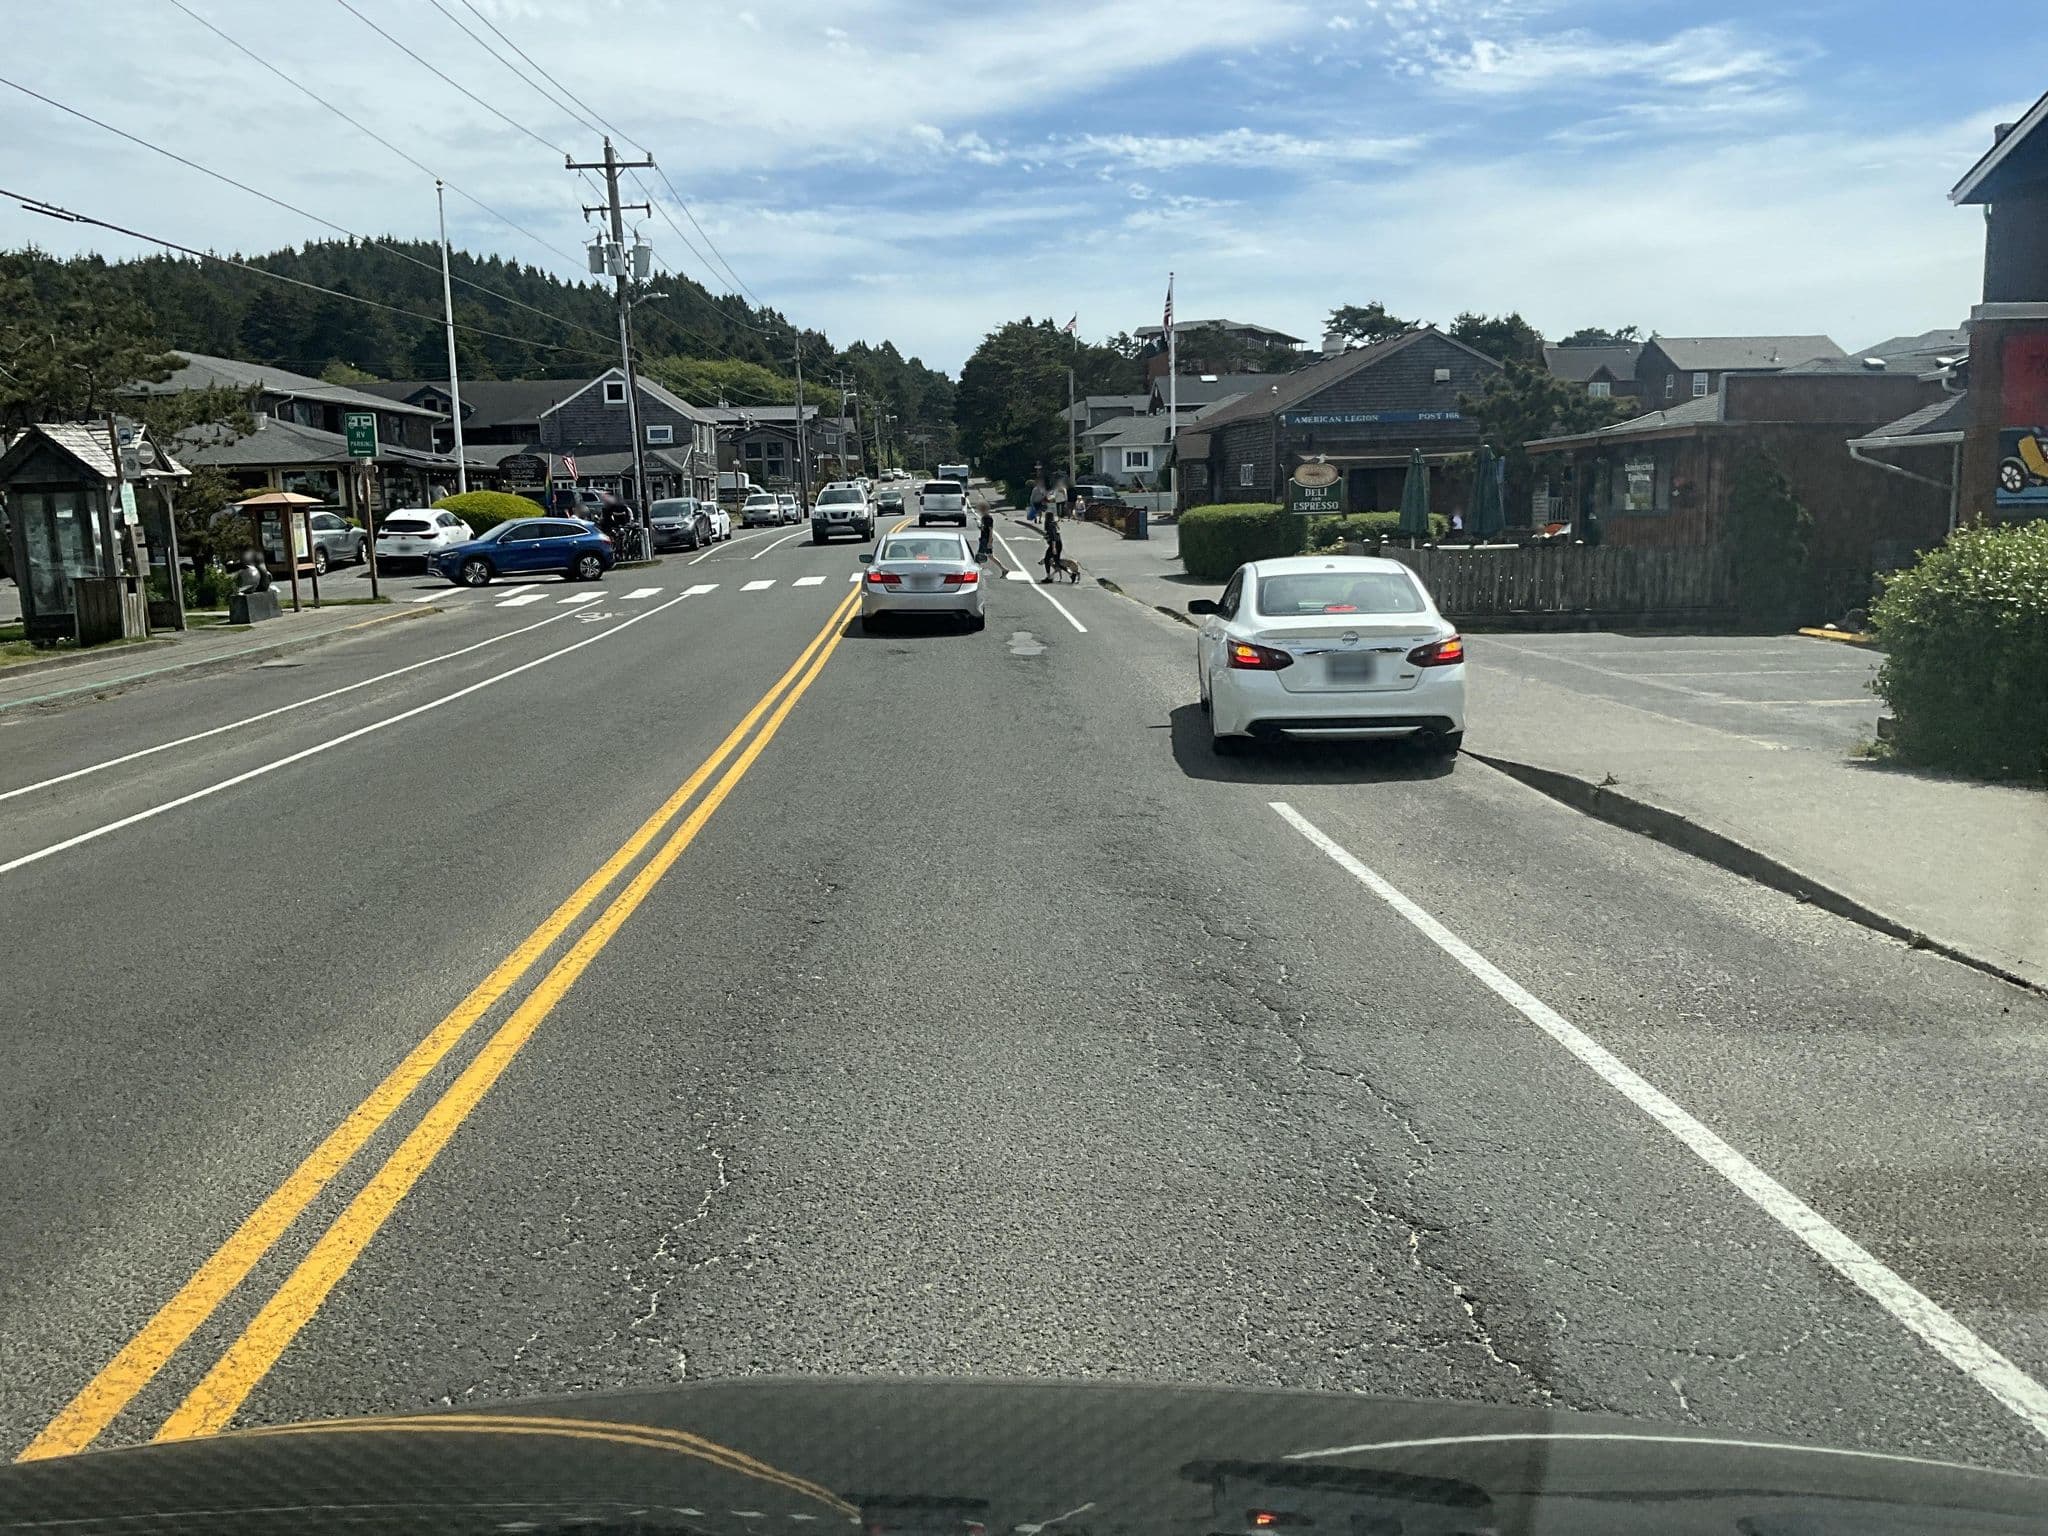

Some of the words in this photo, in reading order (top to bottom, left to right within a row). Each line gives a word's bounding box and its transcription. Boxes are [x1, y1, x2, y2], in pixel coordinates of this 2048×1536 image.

[1294, 415, 1342, 424] AMERICAN
[1344, 414, 1379, 423] LEGION
[1418, 412, 1443, 421] POST
[1305, 488, 1328, 497] DELI
[1293, 501, 1339, 511] ESPRESSO
